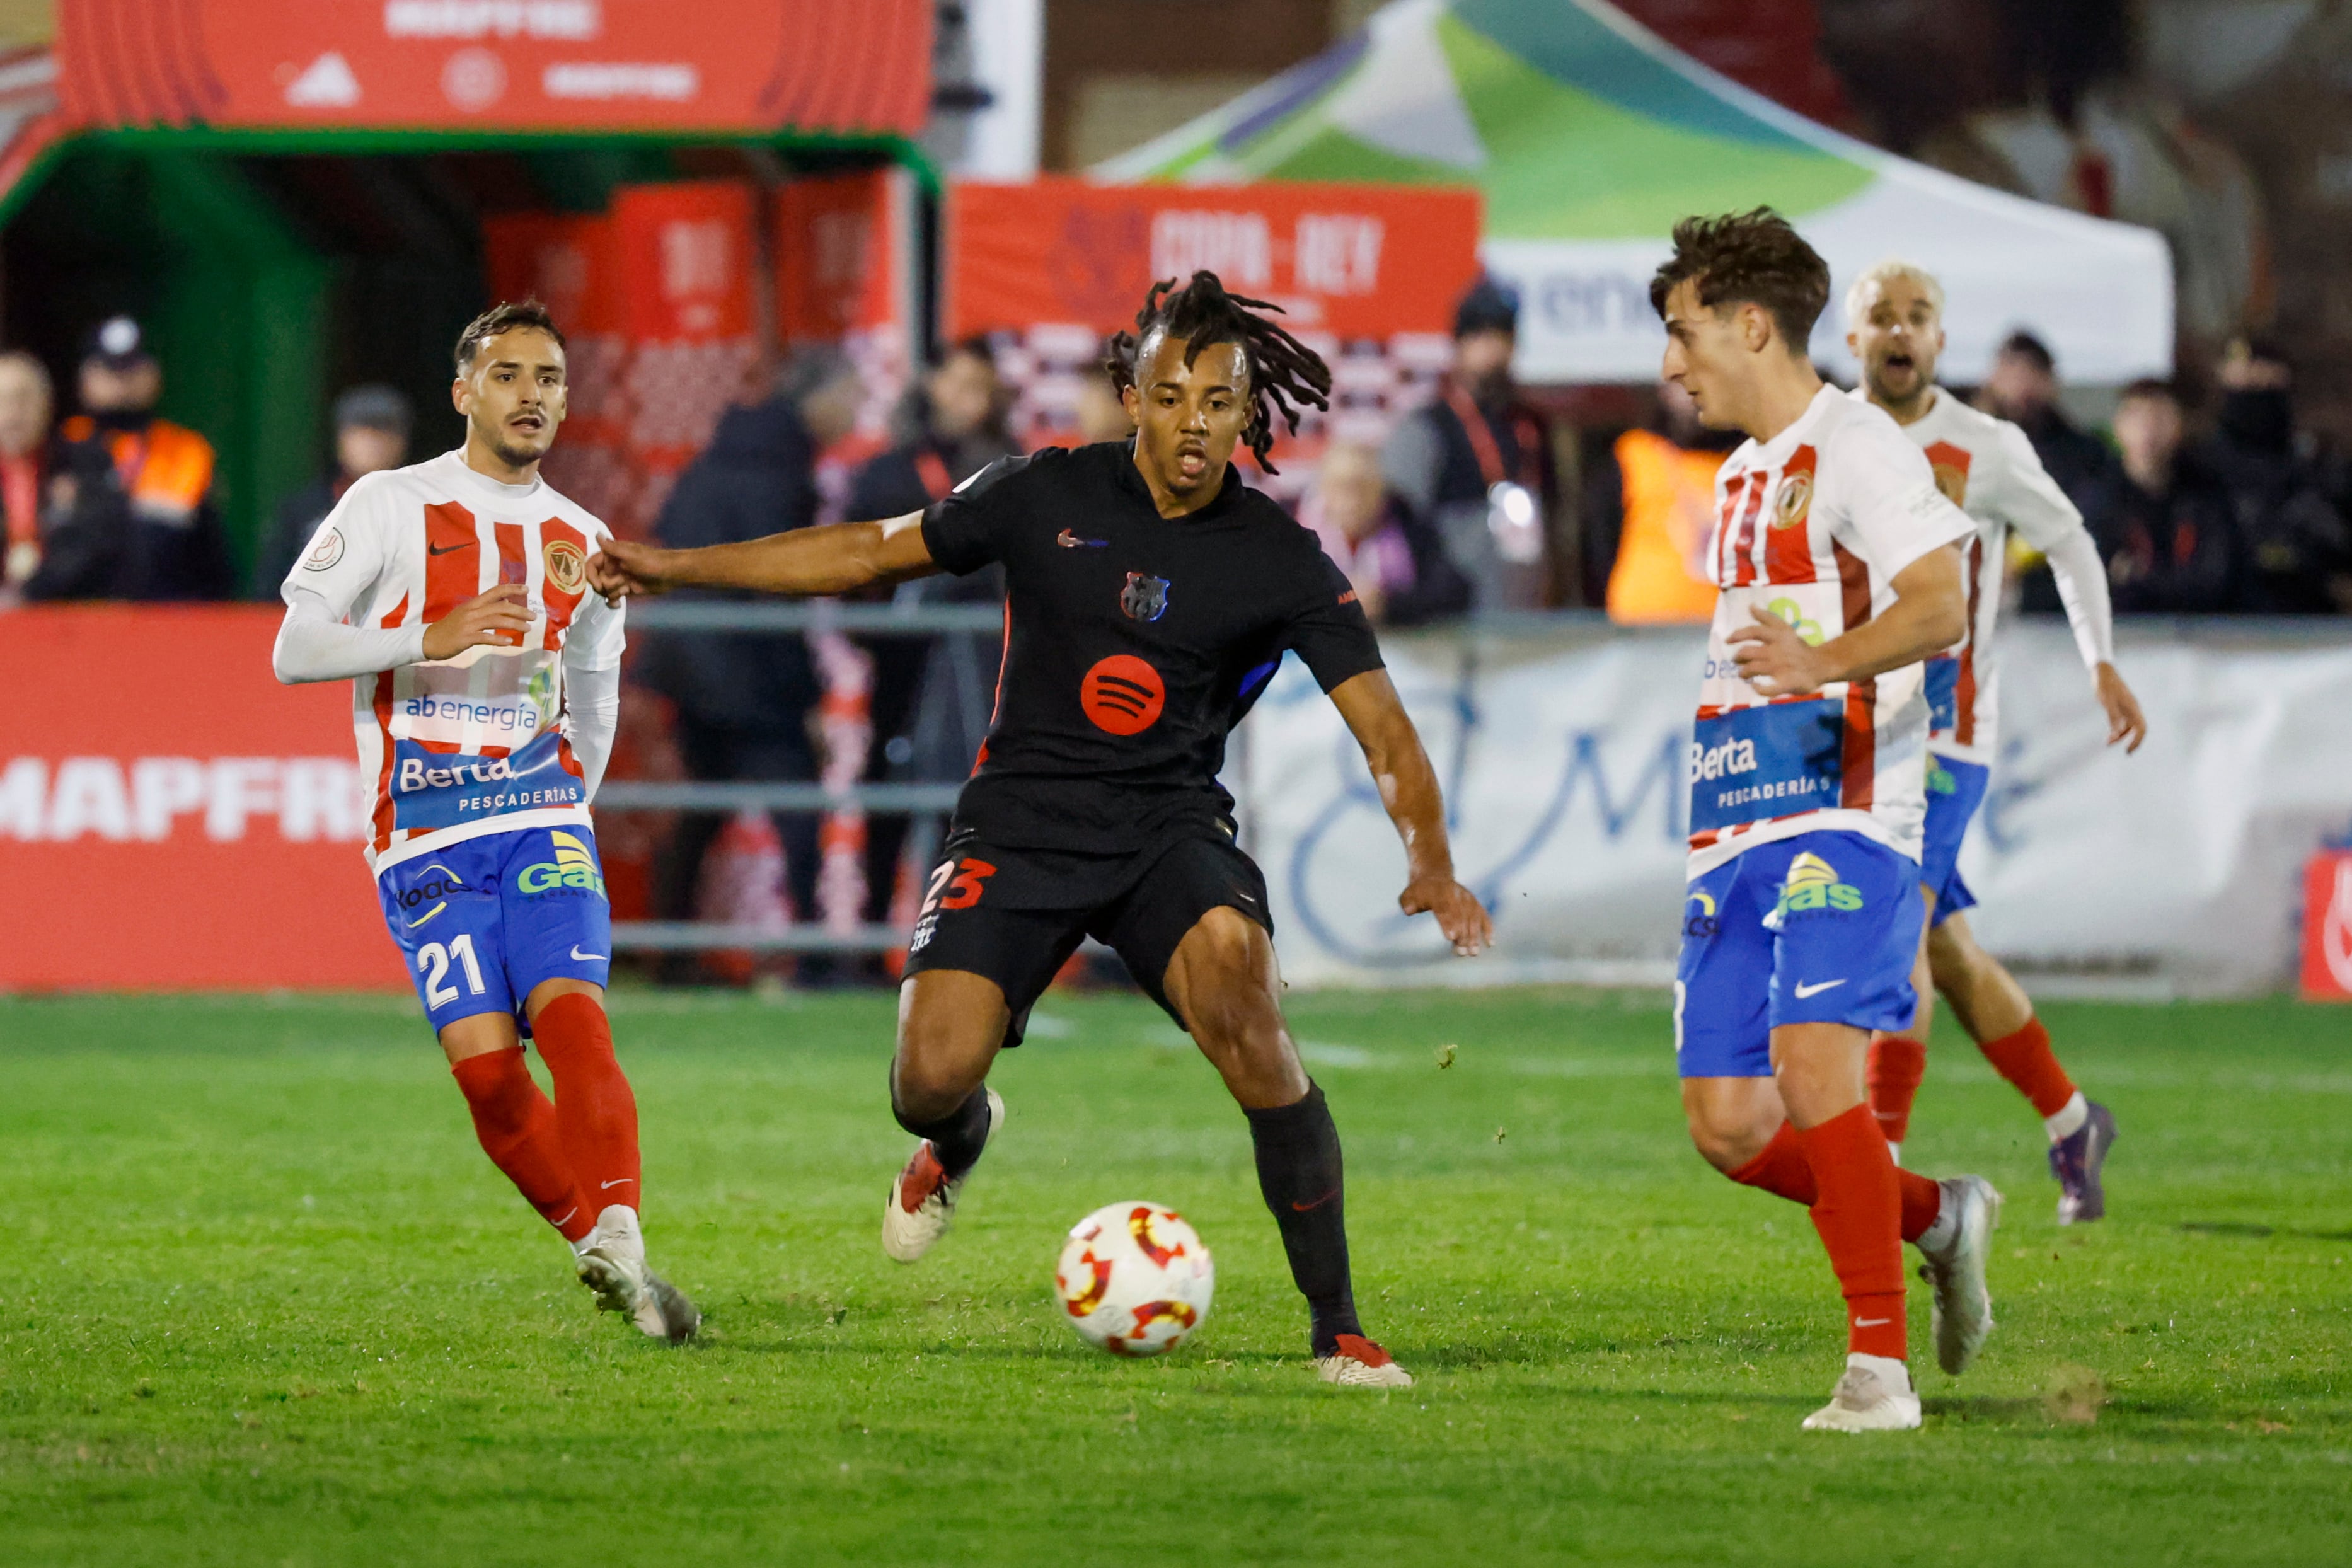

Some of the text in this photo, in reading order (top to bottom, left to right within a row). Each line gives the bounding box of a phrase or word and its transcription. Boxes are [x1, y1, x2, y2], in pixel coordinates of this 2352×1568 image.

[400, 758, 514, 792] Berta
[1689, 736, 1757, 786] Berta
[0, 756, 362, 842] MAPFR
[459, 787, 577, 812] PESCADERÍAS
[918, 857, 998, 921] 23
[418, 934, 485, 1012] 21
